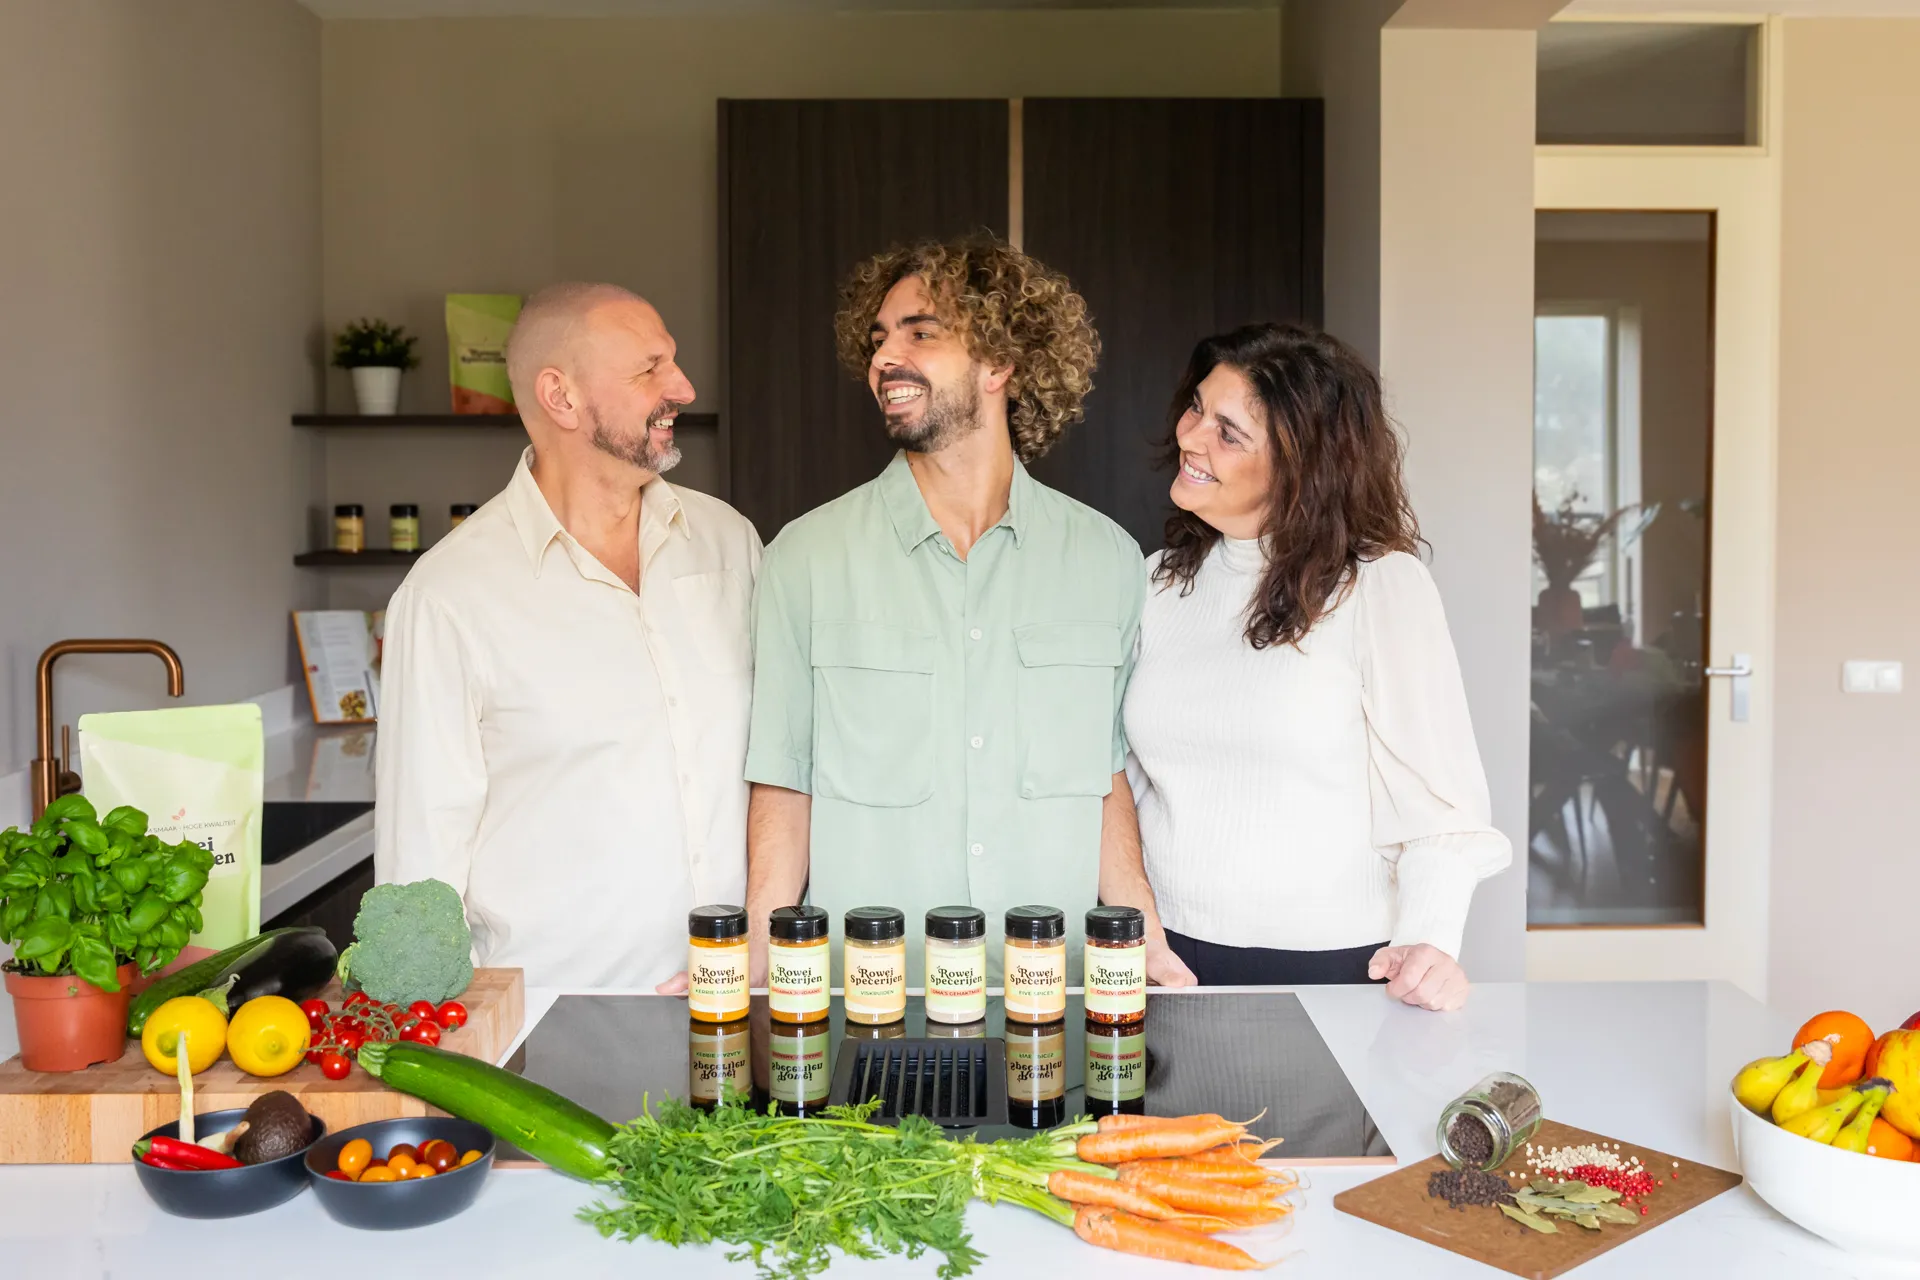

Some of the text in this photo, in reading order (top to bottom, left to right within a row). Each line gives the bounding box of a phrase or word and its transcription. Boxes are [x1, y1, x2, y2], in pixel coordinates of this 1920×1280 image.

[153, 825, 177, 833] SMAAK
[182, 822, 203, 830] HOGE
[204, 819, 236, 828] KWALITEIT
[698, 966, 735, 978] Rowei
[777, 966, 812, 977] Rowei
[857, 967, 894, 978] Rowei
[937, 967, 973, 978] Rowei
[1017, 967, 1054, 978] Rowei
[1097, 967, 1133, 978] Rowei
[692, 973, 745, 985] Specerijen
[771, 972, 822, 985] Specerijen
[850, 974, 903, 986] Specerijen
[930, 974, 982, 986] Specerijen
[1010, 974, 1062, 986] Specerijen
[1090, 974, 1142, 986] Specerijen
